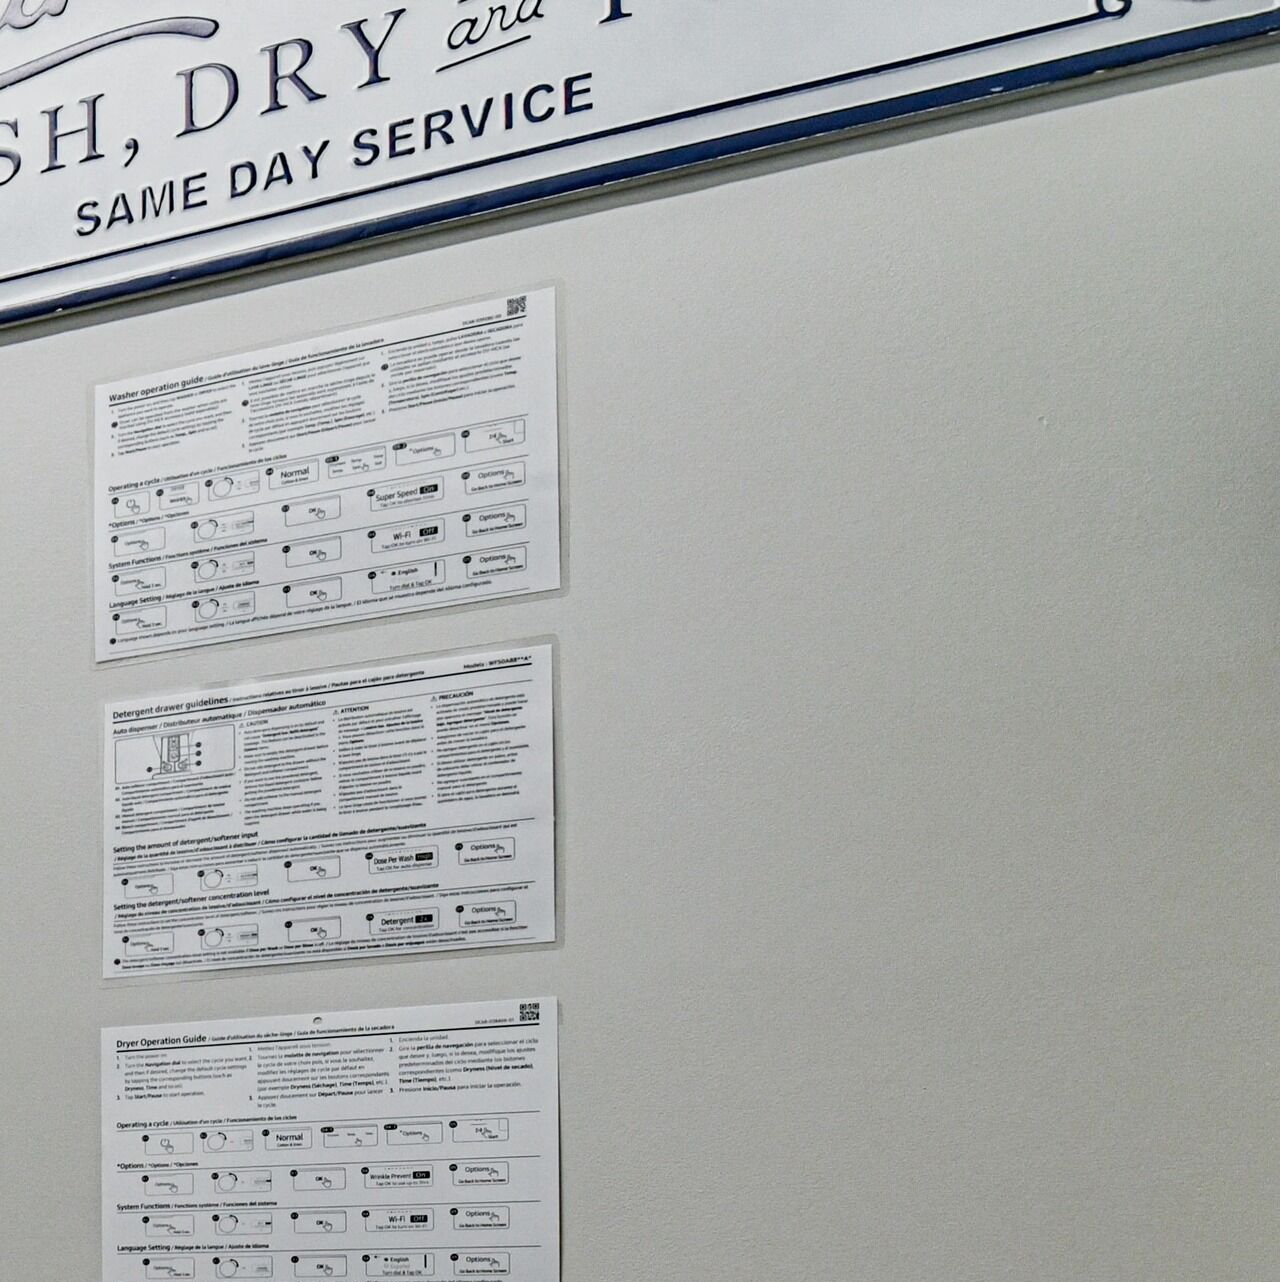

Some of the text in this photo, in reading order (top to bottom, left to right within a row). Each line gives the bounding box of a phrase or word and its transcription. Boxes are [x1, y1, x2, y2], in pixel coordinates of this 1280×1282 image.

[176, 8, 407, 138] DRY
[76, 72, 594, 237] SAME DAY SERVICE
[108, 374, 203, 402] Washer operation guide
[280, 465, 309, 479] Normal
[477, 468, 504, 481] Options
[108, 480, 138, 493] Operating
[143, 476, 159, 486] cycle
[375, 487, 418, 503] Super Speed
[478, 510, 505, 522] Options
[392, 530, 411, 541] Wi-Fi
[422, 526, 435, 535] Off
[108, 554, 161, 570] System Functions
[479, 552, 506, 564] Options
[397, 566, 418, 577] English
[109, 594, 161, 609] Language Setting
[112, 695, 228, 720] Detergent drawer guidelines
[247, 705, 286, 717] Dispensador
[340, 705, 369, 714] ATTENTION
[163, 711, 241, 728] Distributeur automatique
[112, 723, 157, 735] Auto dispenser
[112, 845, 134, 854] Setting
[147, 840, 170, 849] amount
[179, 833, 240, 847] detergent/softener
[241, 831, 258, 840] input
[470, 841, 495, 852] Options
[373, 853, 413, 865] Dose Per Wash
[113, 902, 135, 912] Setting
[147, 895, 207, 908] detergent/softener
[208, 890, 252, 901] concentration
[253, 889, 269, 897] level
[471, 905, 496, 915] Options
[380, 915, 413, 927] Detergent
[115, 1034, 206, 1049] Dryer Operation Guide
[116, 1120, 147, 1129] Operating
[152, 1119, 168, 1128] cycle
[275, 1132, 303, 1142] Normal
[465, 1165, 489, 1174] Options
[116, 1203, 139, 1211] System
[388, 1215, 405, 1223] Wi-Fi
[465, 1209, 490, 1218] Options
[117, 1243, 170, 1252] Language Setting
[465, 1255, 490, 1264] Options
